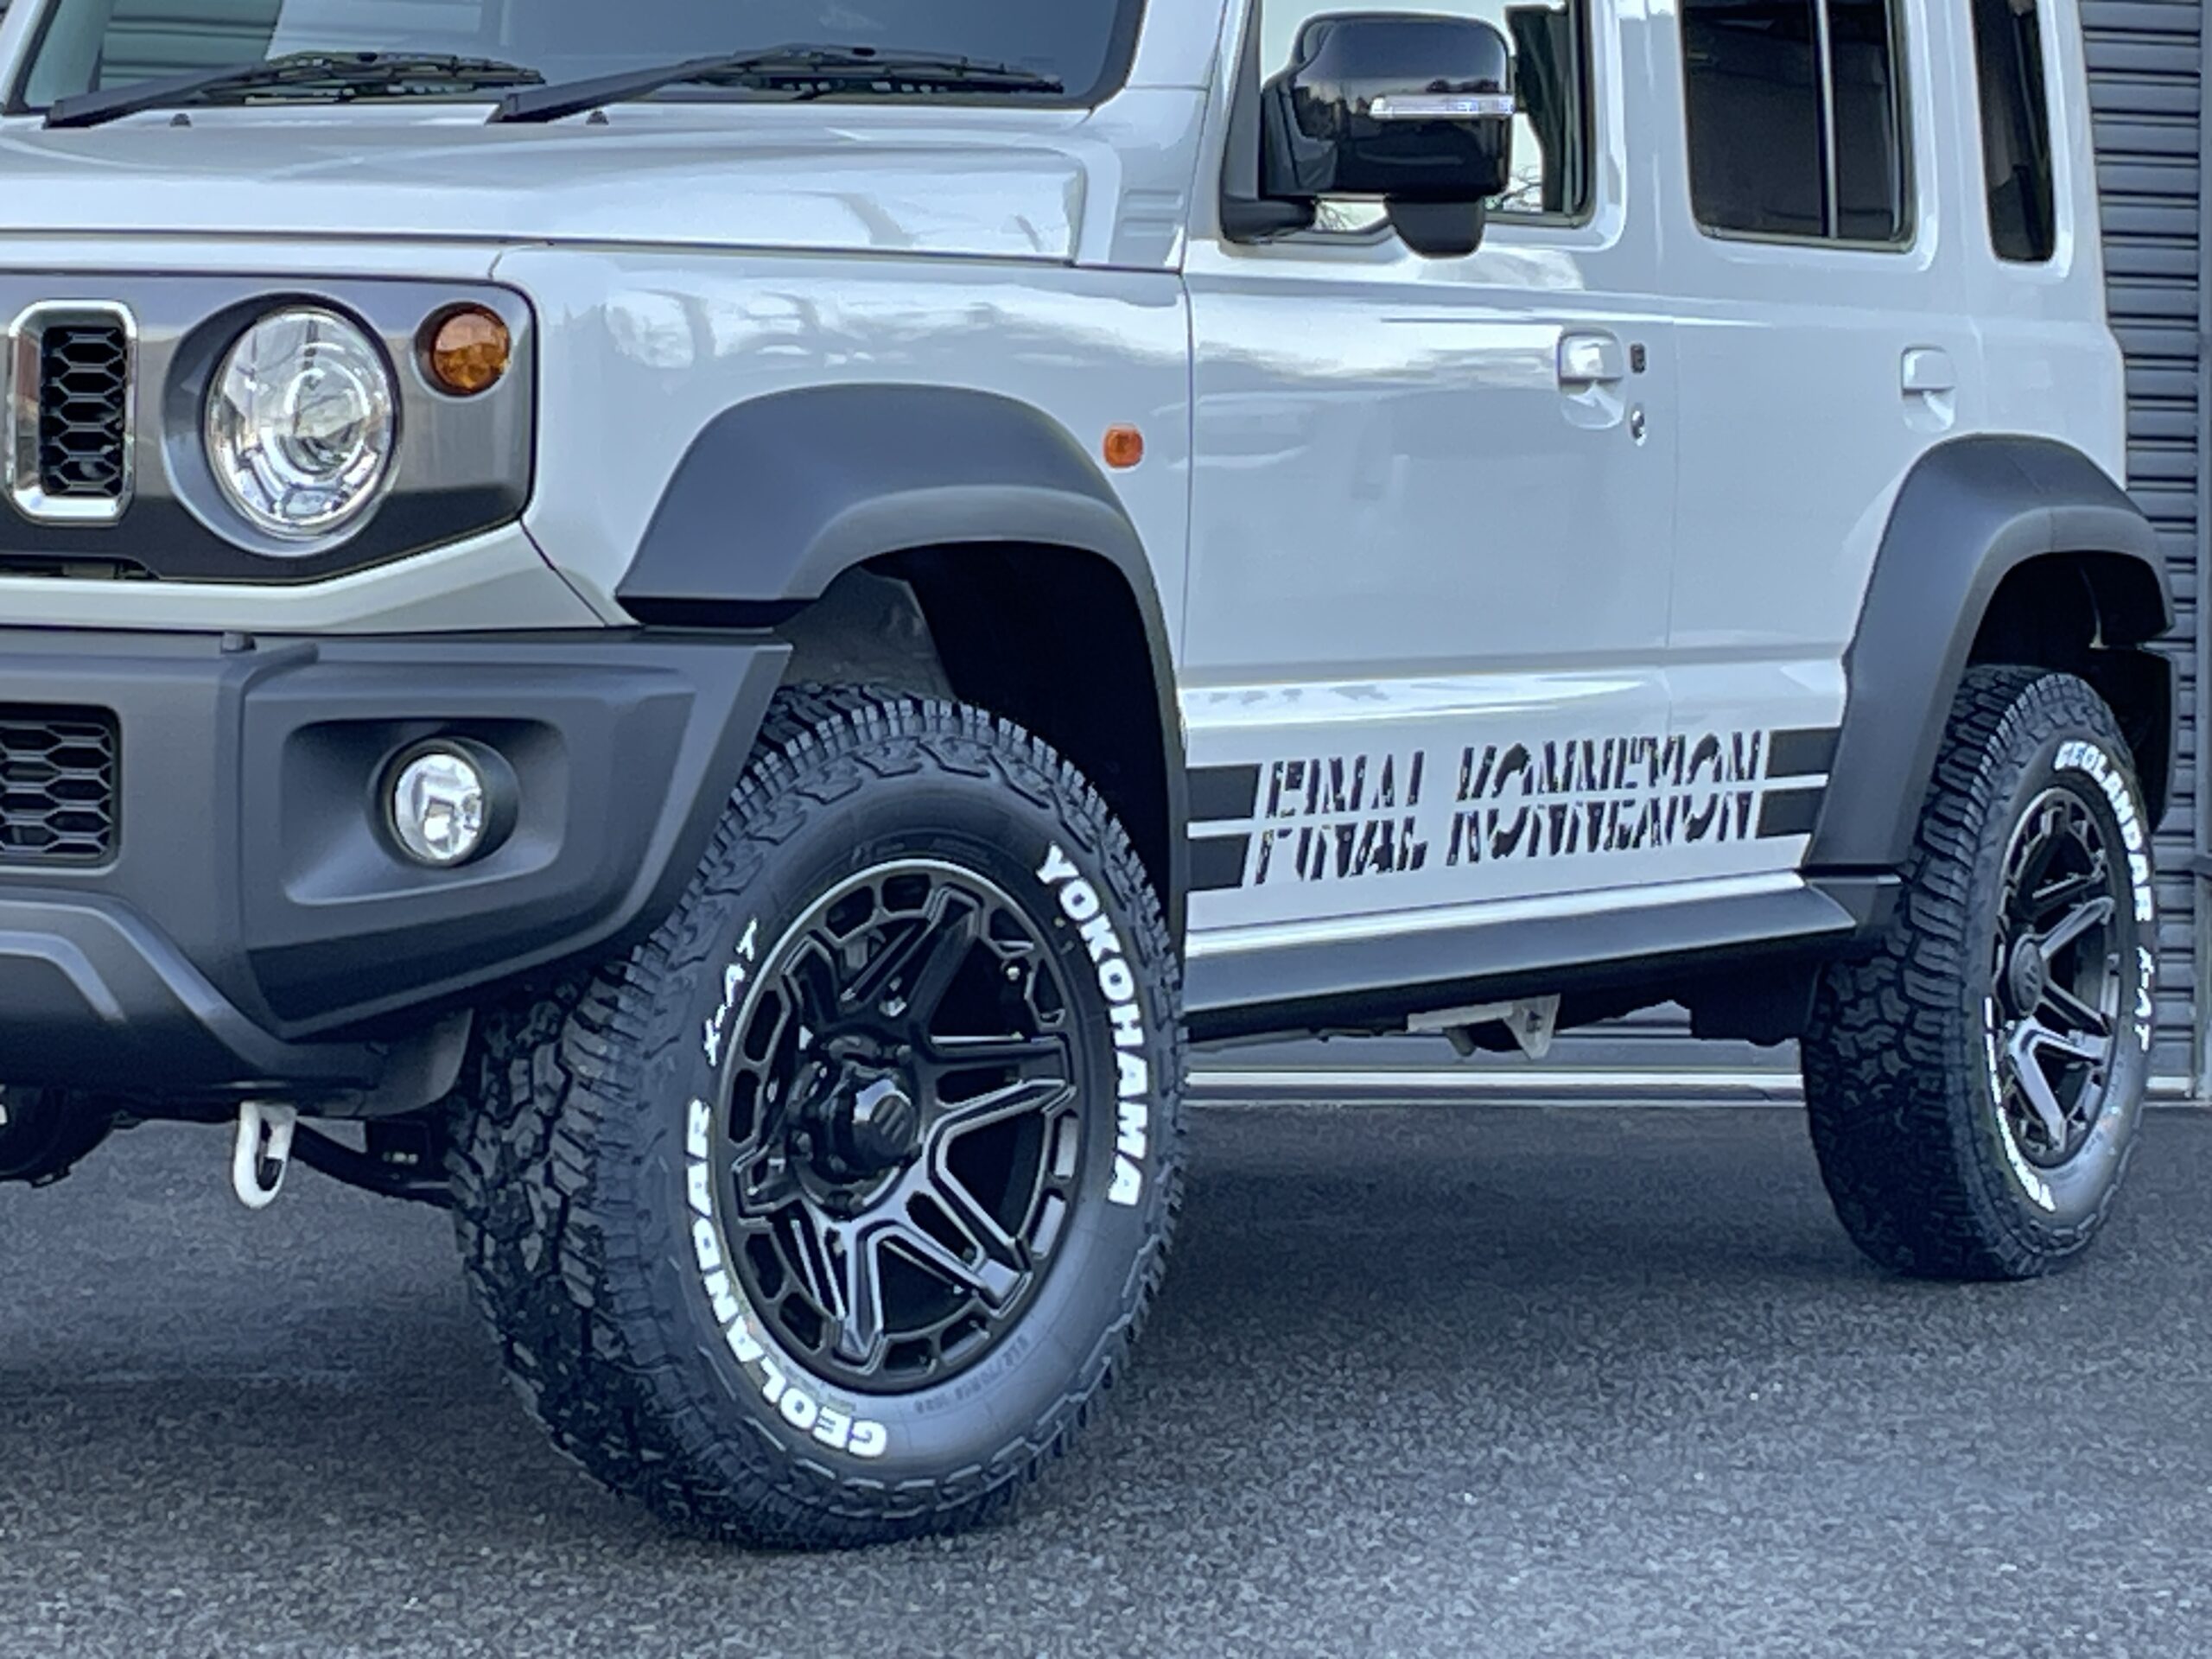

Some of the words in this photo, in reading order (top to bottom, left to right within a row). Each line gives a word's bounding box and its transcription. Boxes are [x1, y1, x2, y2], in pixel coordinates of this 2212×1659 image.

[1255, 750, 1428, 886] FINAL
[2054, 741, 2153, 922] GEOLANDAR
[1037, 841, 1148, 1205] YOKOHAMA
[687, 1098, 887, 1457] GEOLANDAR
